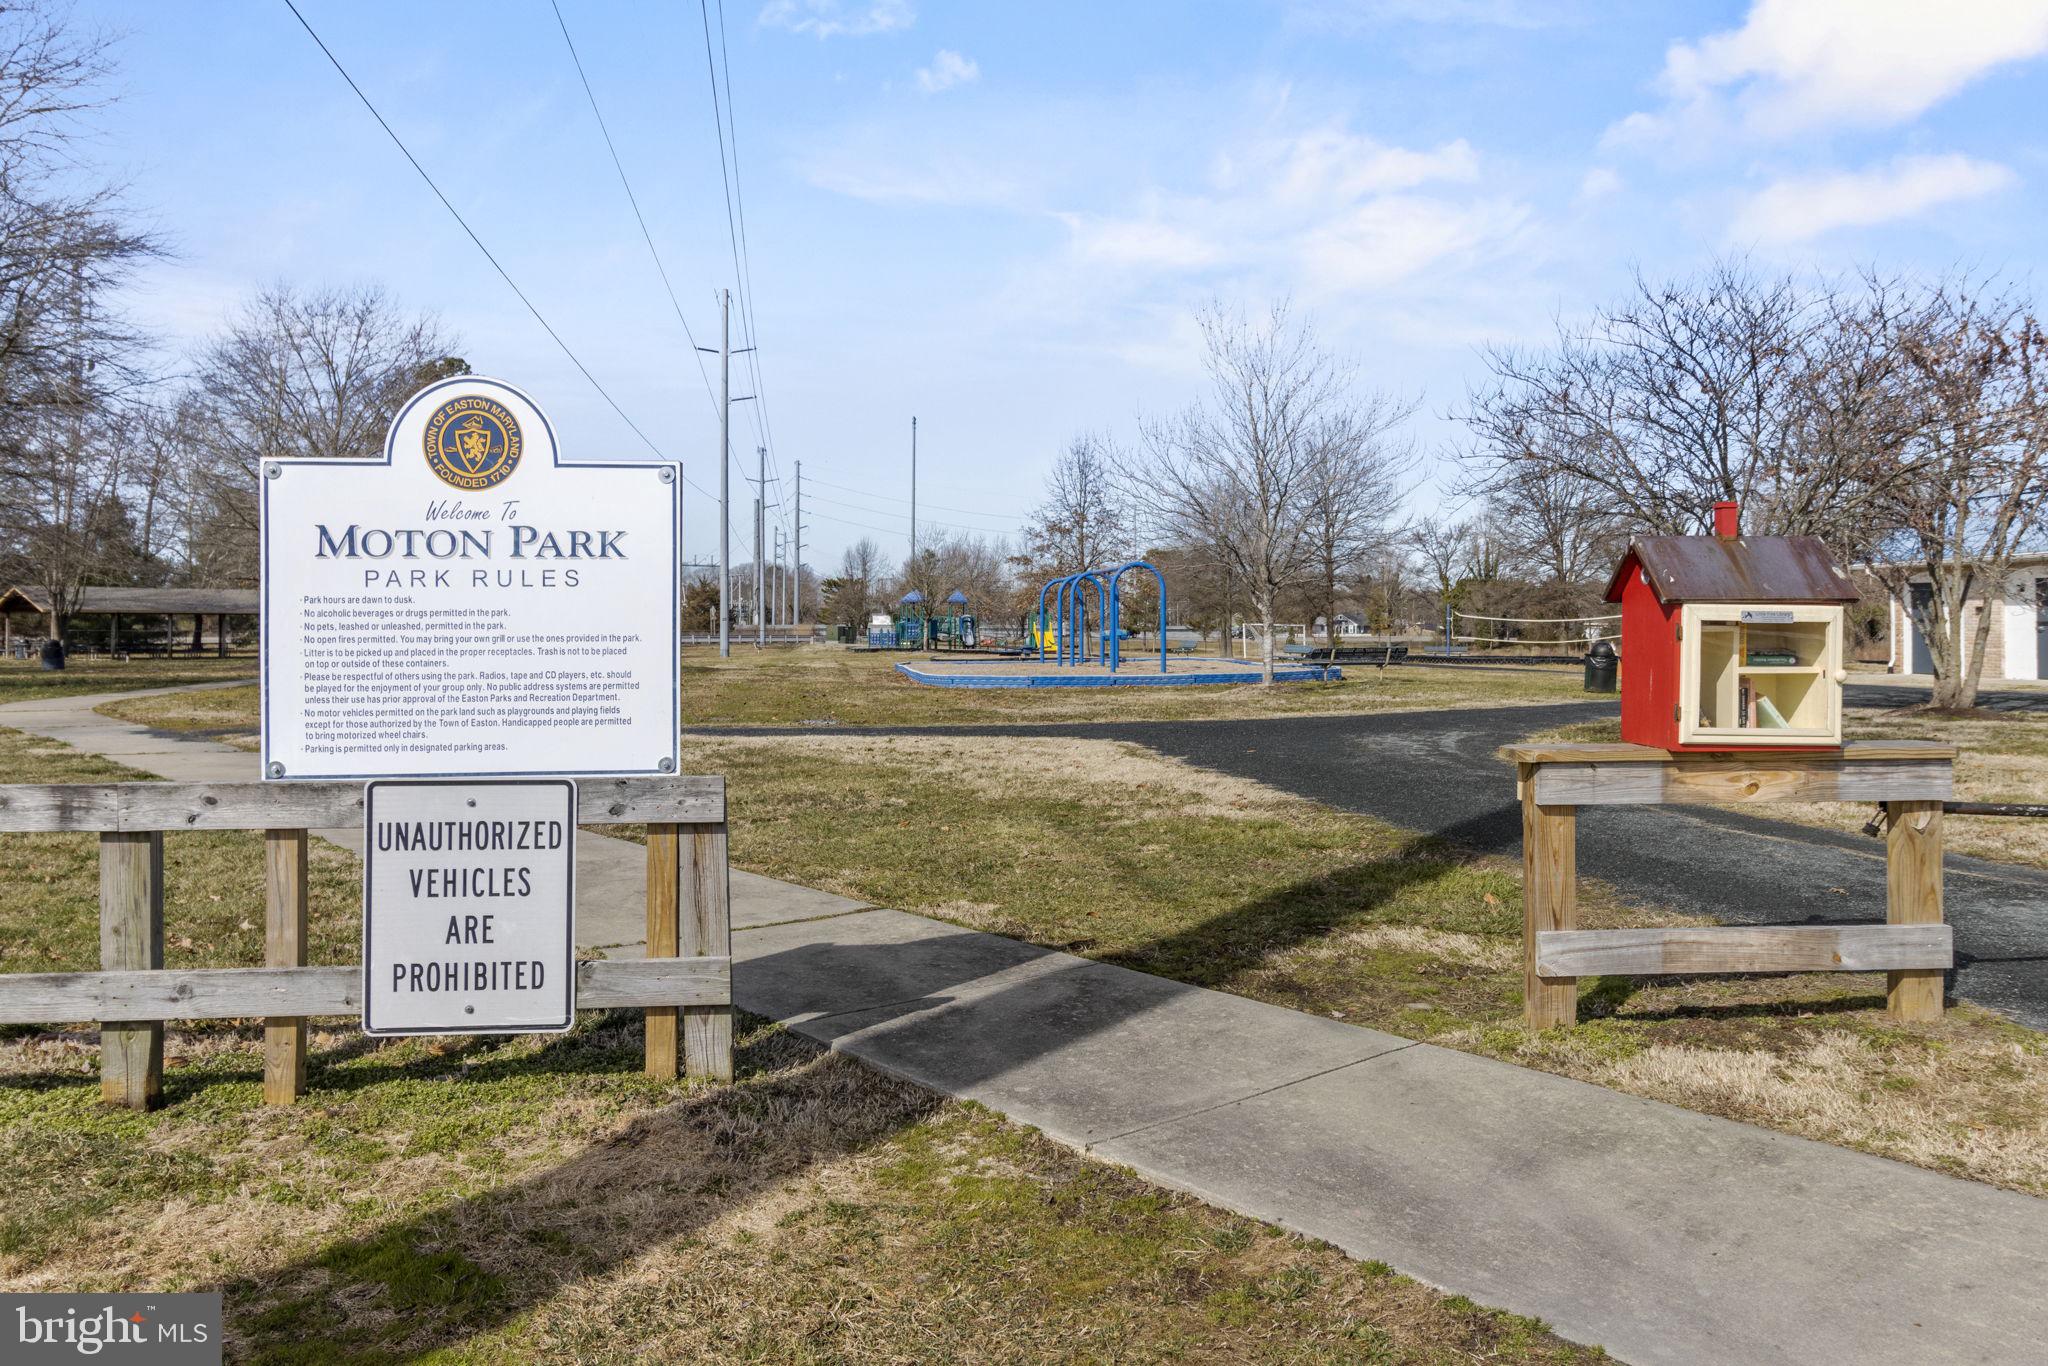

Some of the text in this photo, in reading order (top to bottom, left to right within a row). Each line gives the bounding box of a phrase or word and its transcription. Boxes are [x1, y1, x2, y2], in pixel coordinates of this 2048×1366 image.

[427, 399, 519, 458] TOWN OF EASTON MARYLAND
[435, 464, 510, 487] FOUNDED 1710
[426, 500, 520, 521] Welcome To
[315, 524, 629, 559] MOTON PARK
[365, 569, 580, 587] PARK RULES
[303, 596, 322, 604] Park
[323, 595, 346, 604] hours
[361, 595, 383, 604] dawn
[384, 595, 393, 604] to
[394, 595, 415, 604] dusk.
[304, 609, 315, 617] No
[317, 609, 351, 617] alcoholic
[352, 609, 394, 619] beverages
[405, 608, 428, 619] drugs
[429, 608, 468, 619] permitted
[468, 608, 476, 617] in
[477, 608, 490, 617] the
[491, 608, 510, 618] park.
[304, 622, 315, 631] No
[338, 622, 370, 630] leashed
[425, 622, 463, 632] permitted
[464, 621, 471, 630] in
[472, 621, 485, 630] the
[486, 621, 506, 632] park.
[304, 646, 627, 659] Litter is to be picked up and placed in the proper receptacles. Trash is not to be placed
[316, 659, 330, 670] top
[341, 659, 371, 668] outside
[372, 659, 380, 667] of
[382, 659, 404, 667] these
[405, 659, 449, 667] containers.
[304, 672, 330, 680] Please
[331, 672, 342, 680] be
[343, 672, 384, 682] respectful
[385, 672, 393, 680] of
[394, 671, 420, 680] others
[421, 671, 442, 682] using
[443, 671, 456, 680] the
[457, 671, 477, 681] park.
[510, 671, 528, 681] tape
[529, 670, 544, 679] and
[545, 670, 557, 679] CD
[590, 670, 604, 678] etc.
[606, 670, 632, 678] should
[304, 684, 315, 692] be
[316, 684, 342, 694] played
[343, 684, 354, 692] for
[356, 683, 370, 692] the
[371, 683, 412, 694] enjoyment
[413, 683, 421, 691] of
[423, 684, 440, 693] your
[442, 684, 465, 693] group
[466, 682, 484, 693] only.
[486, 682, 498, 691] No
[499, 682, 522, 692] public
[523, 682, 554, 690] address
[555, 681, 588, 692] systems
[602, 681, 640, 691] permitted
[305, 695, 330, 703] unless
[331, 695, 349, 703] their
[366, 694, 381, 703] has
[382, 694, 401, 705] prior
[402, 694, 436, 704] approval
[437, 694, 446, 702] of
[447, 694, 460, 702] the
[461, 693, 489, 702] Easton
[490, 693, 512, 702] Parks
[513, 693, 528, 701] and
[529, 693, 571, 701] Recreation
[572, 692, 620, 703] Department.
[304, 708, 316, 717] No
[317, 708, 340, 717] motor
[342, 708, 374, 716] vehicles
[375, 708, 414, 718] permitted
[426, 707, 439, 716] the
[440, 707, 458, 717] park
[459, 707, 476, 715] land
[476, 707, 496, 715] such
[507, 706, 555, 717] playgrounds
[556, 706, 571, 714] and
[571, 706, 599, 716] playing
[600, 705, 620, 714] fields
[305, 720, 331, 730] except
[332, 719, 344, 728] for
[346, 719, 368, 728] those
[369, 719, 412, 727] authorized
[412, 719, 422, 729] by
[424, 718, 437, 727] the
[439, 718, 460, 727] Town
[461, 718, 469, 726] of
[470, 718, 500, 726] Easton.
[501, 718, 552, 728] Handicapped
[553, 717, 580, 728] people
[594, 717, 632, 727] permitted
[305, 730, 428, 741] to bring motorized wheel chairs.
[305, 744, 334, 755] Parking
[335, 744, 342, 752] is
[343, 744, 382, 754] permitted
[383, 743, 400, 754] only
[401, 743, 408, 752] in
[409, 743, 453, 753] designated
[454, 742, 483, 753] parking
[378, 821, 562, 851] UNAUTHORIZED
[410, 867, 531, 897] VEHICLES
[446, 916, 494, 944] ARE
[393, 961, 544, 992] PROHIBITED
